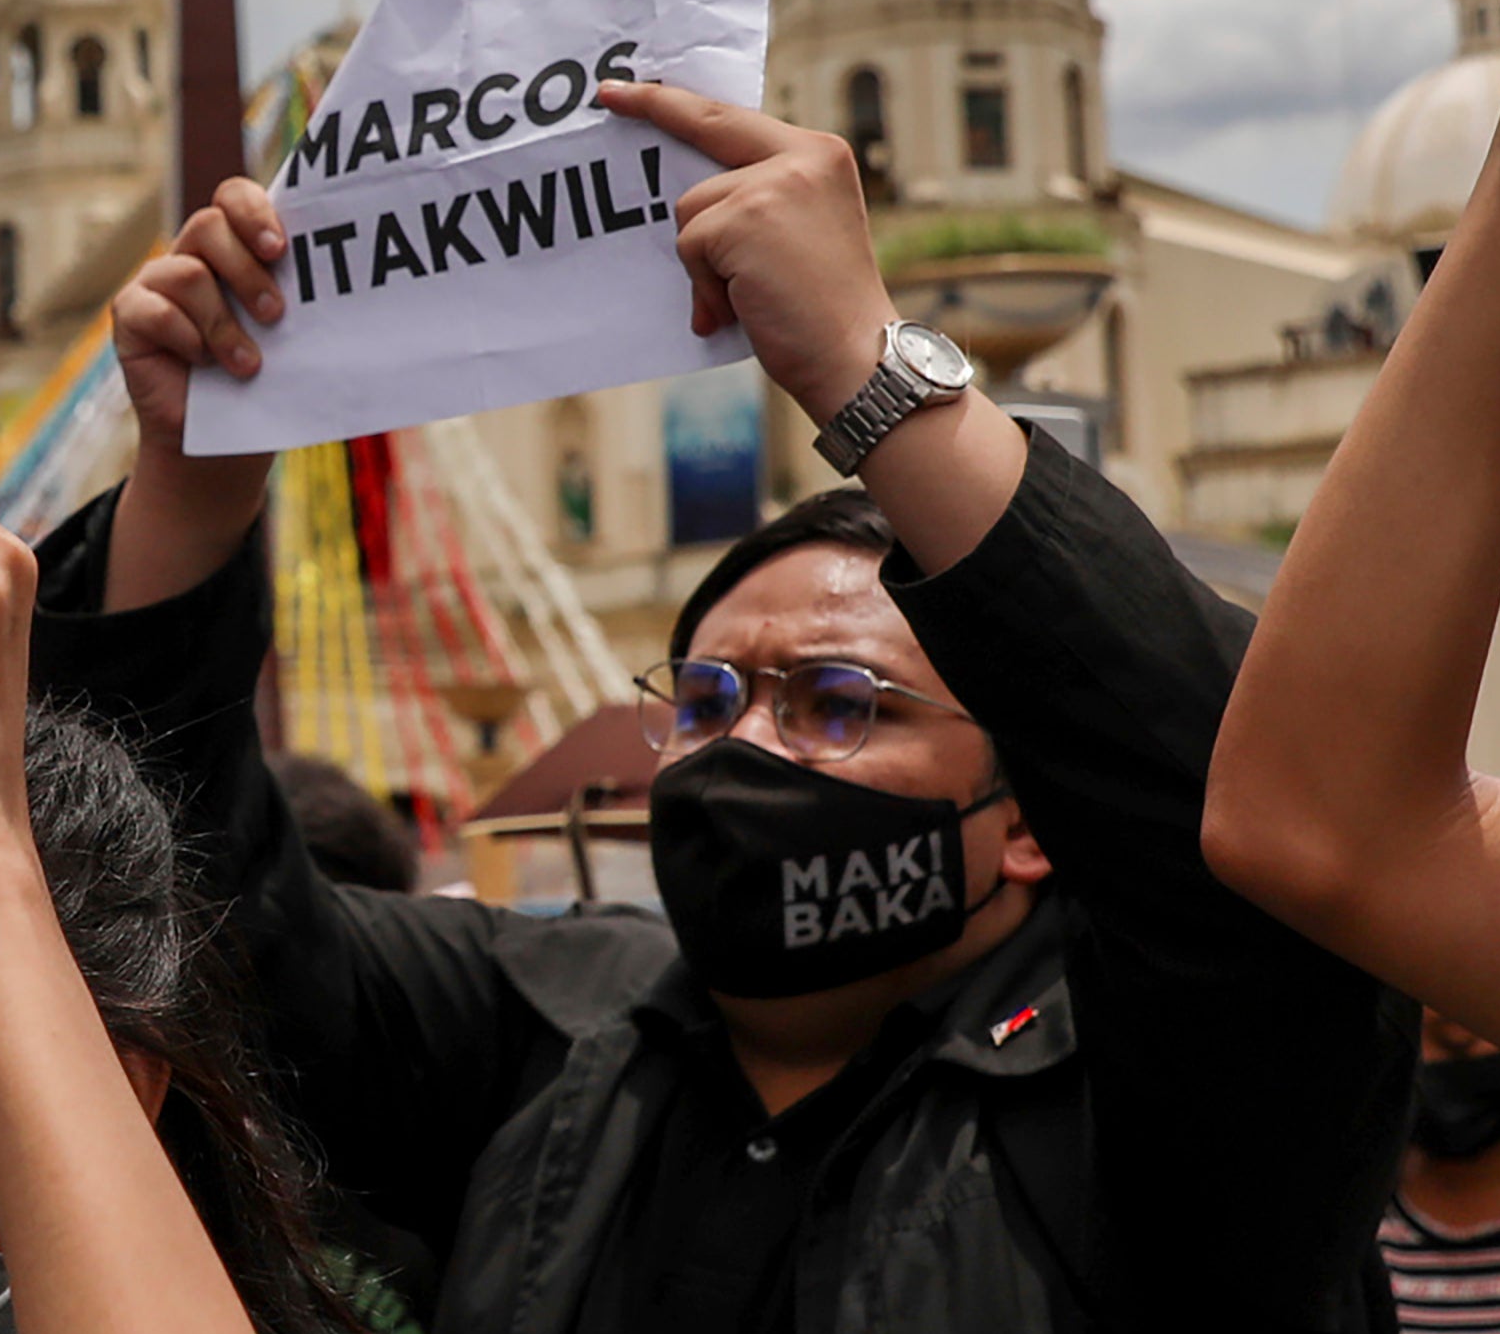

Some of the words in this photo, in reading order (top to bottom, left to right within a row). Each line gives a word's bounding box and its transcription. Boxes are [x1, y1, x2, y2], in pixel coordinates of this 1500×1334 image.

[286, 41, 662, 188] MARCOS
[292, 146, 670, 303] ITAKWIL!
[782, 829, 943, 902] MAKI
[783, 875, 955, 949] BAKA
